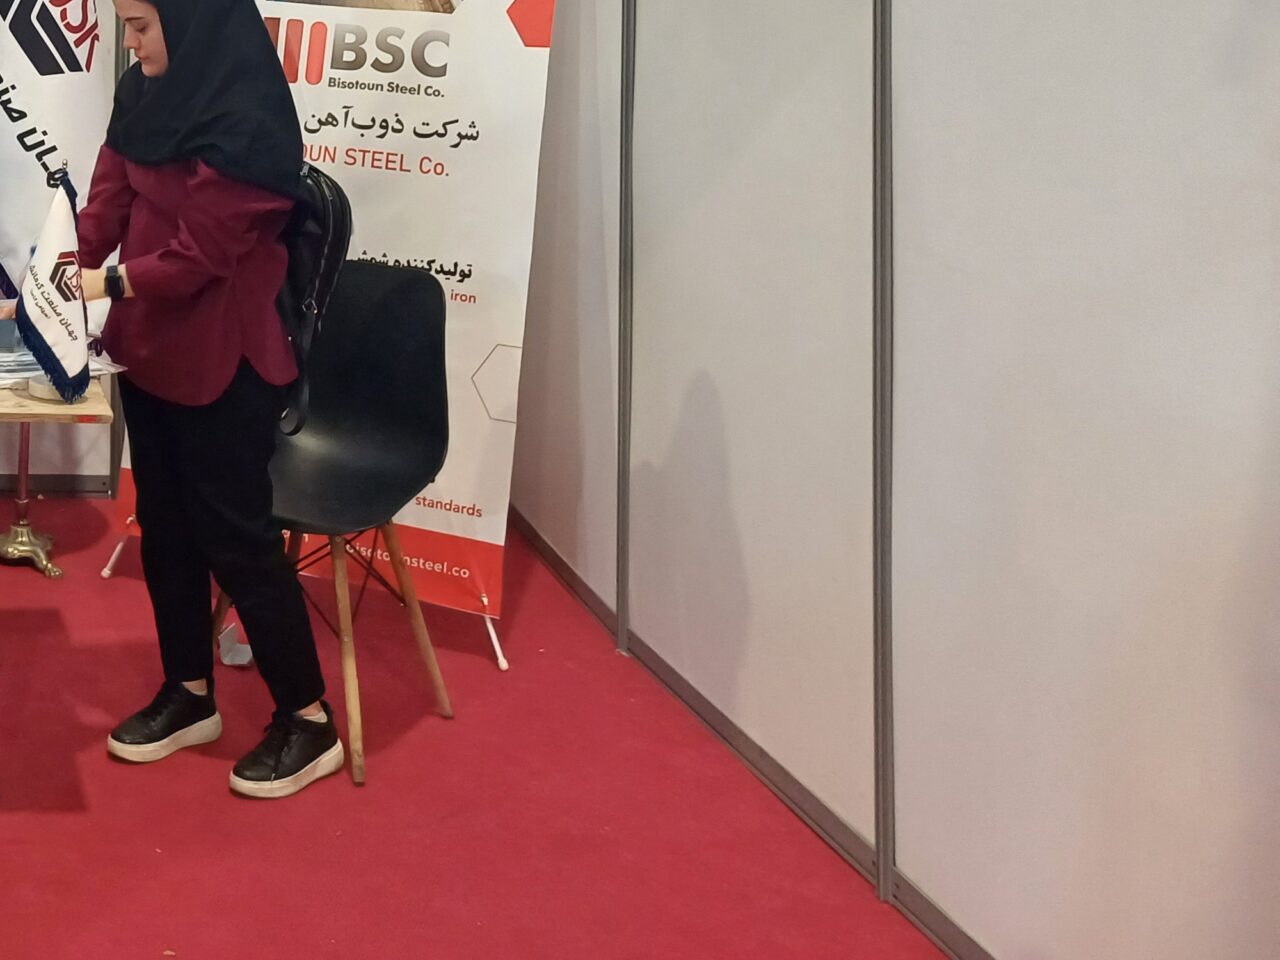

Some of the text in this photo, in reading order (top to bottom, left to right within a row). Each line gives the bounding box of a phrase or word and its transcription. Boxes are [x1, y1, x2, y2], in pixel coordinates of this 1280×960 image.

[330, 23, 450, 78] BSC
[327, 76, 446, 98] Bisotoun Steel Co.
[412, 119, 480, 149] شرکت
[343, 147, 412, 173] STEEL
[419, 156, 450, 177] Co.
[450, 289, 477, 304] iron
[415, 494, 483, 518] standards
